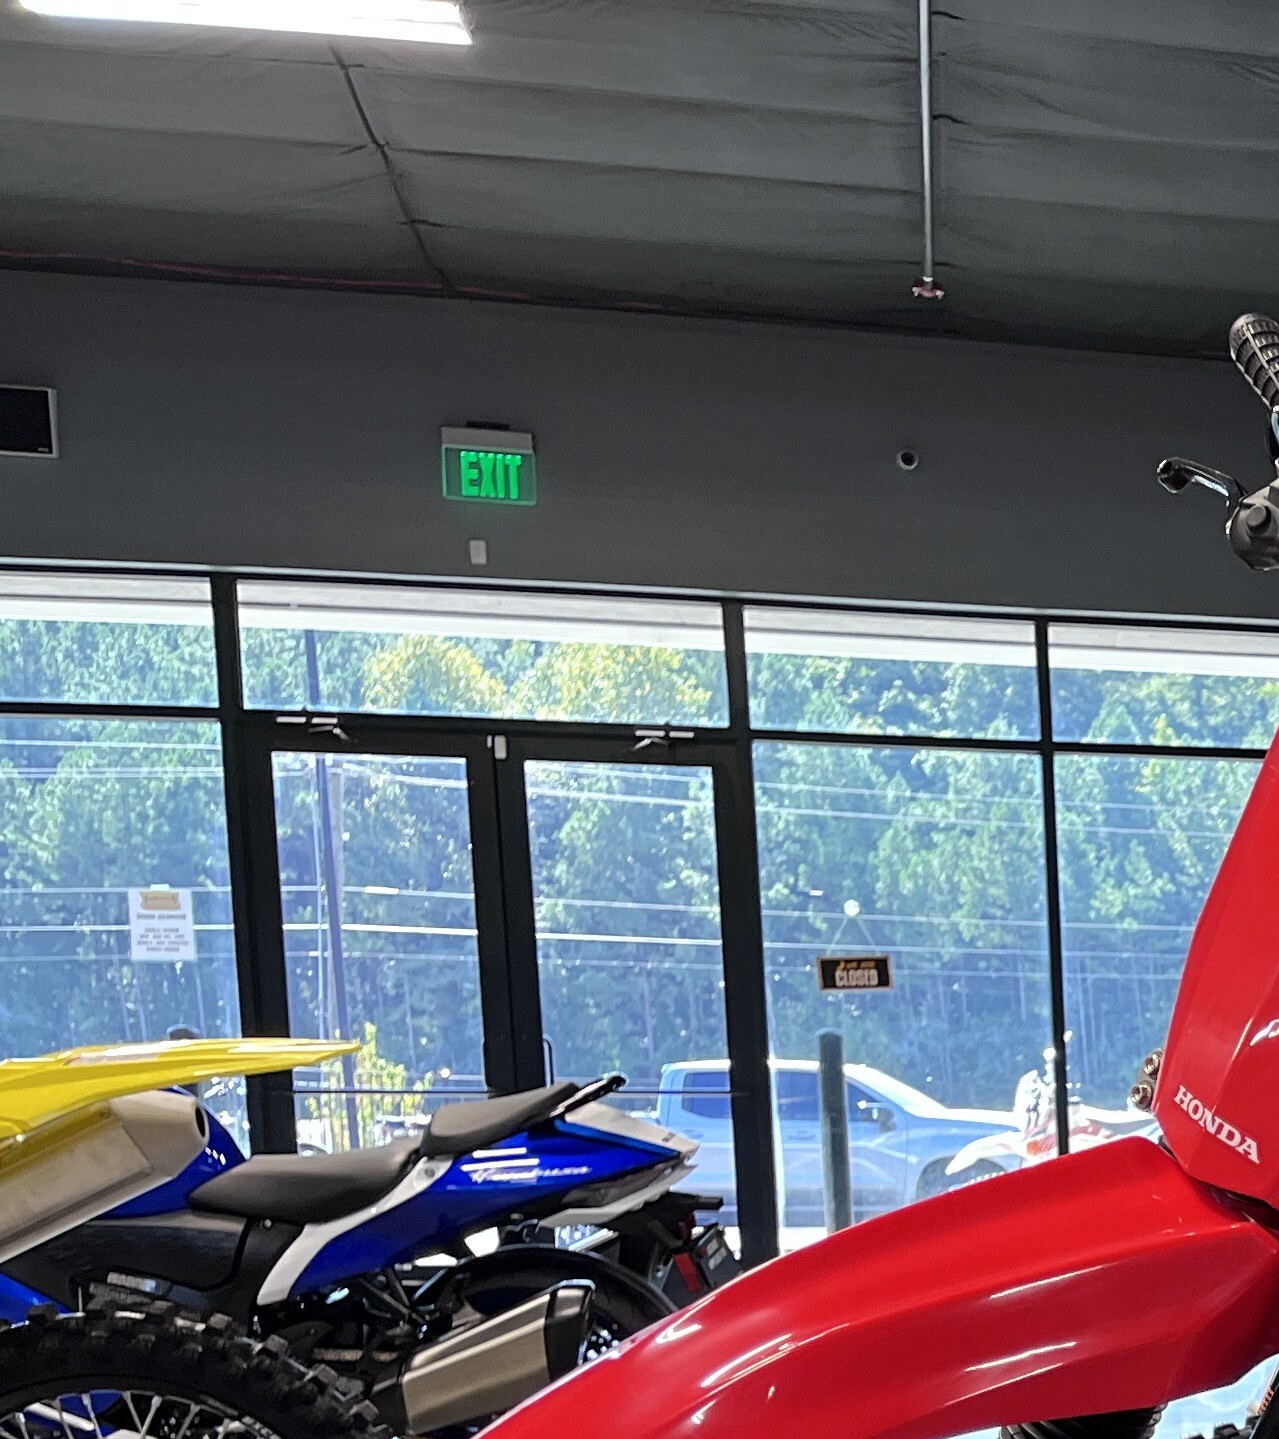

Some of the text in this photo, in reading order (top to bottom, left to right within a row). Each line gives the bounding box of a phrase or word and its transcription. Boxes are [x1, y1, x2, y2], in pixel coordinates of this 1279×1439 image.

[460, 451, 522, 500] EXIT
[835, 968, 879, 988] CLOSED
[1173, 1084, 1260, 1165] HONDA
